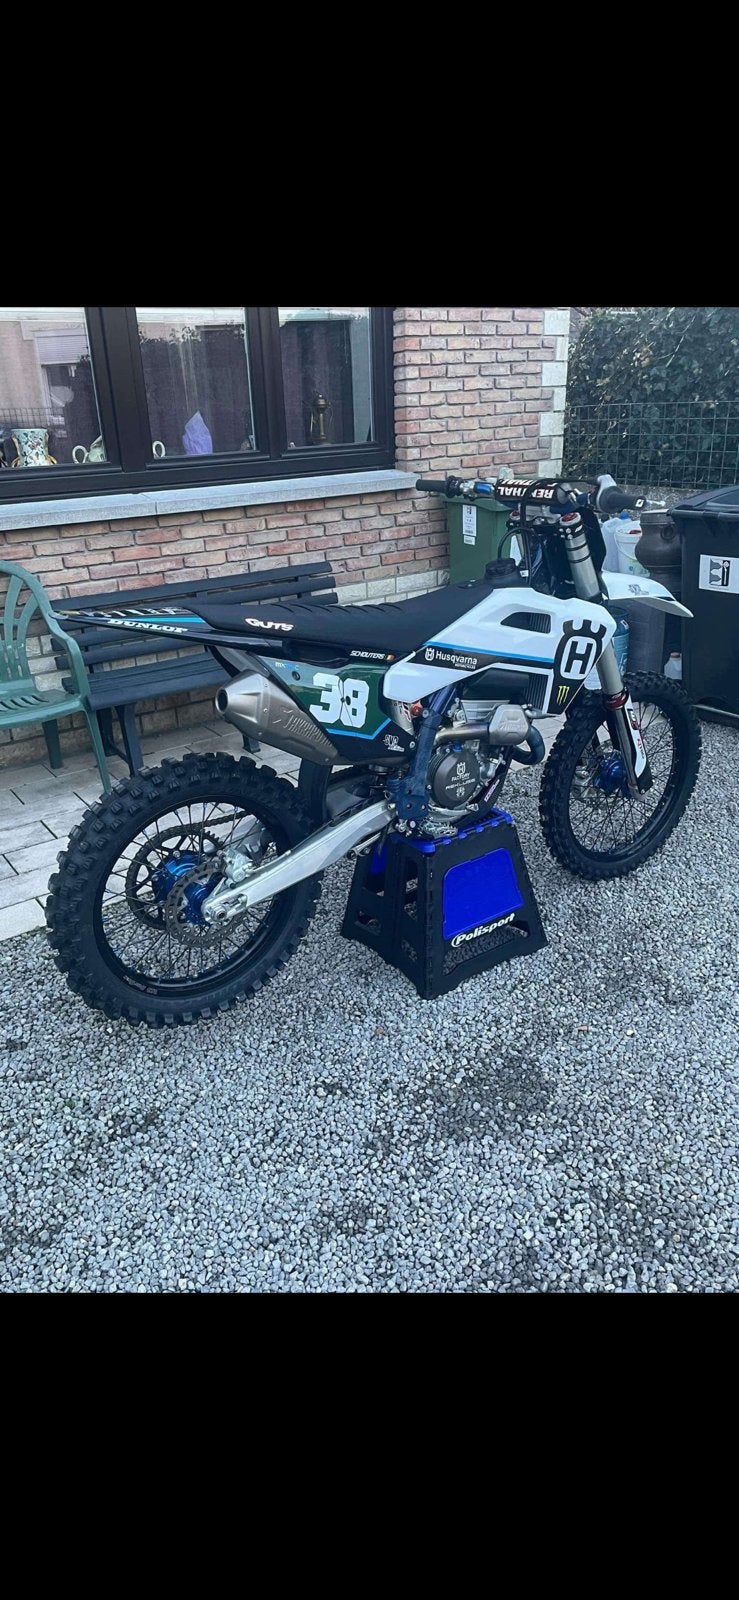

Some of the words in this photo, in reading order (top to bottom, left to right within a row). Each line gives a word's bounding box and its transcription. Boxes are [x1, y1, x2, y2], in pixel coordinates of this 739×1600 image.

[107, 619, 188, 633] DUNLOP
[245, 618, 294, 631] GUTS
[350, 650, 385, 660] SCHOUTERS
[435, 651, 478, 665] Husqvarna
[309, 672, 370, 728] 38
[453, 912, 515, 946] Polisport
